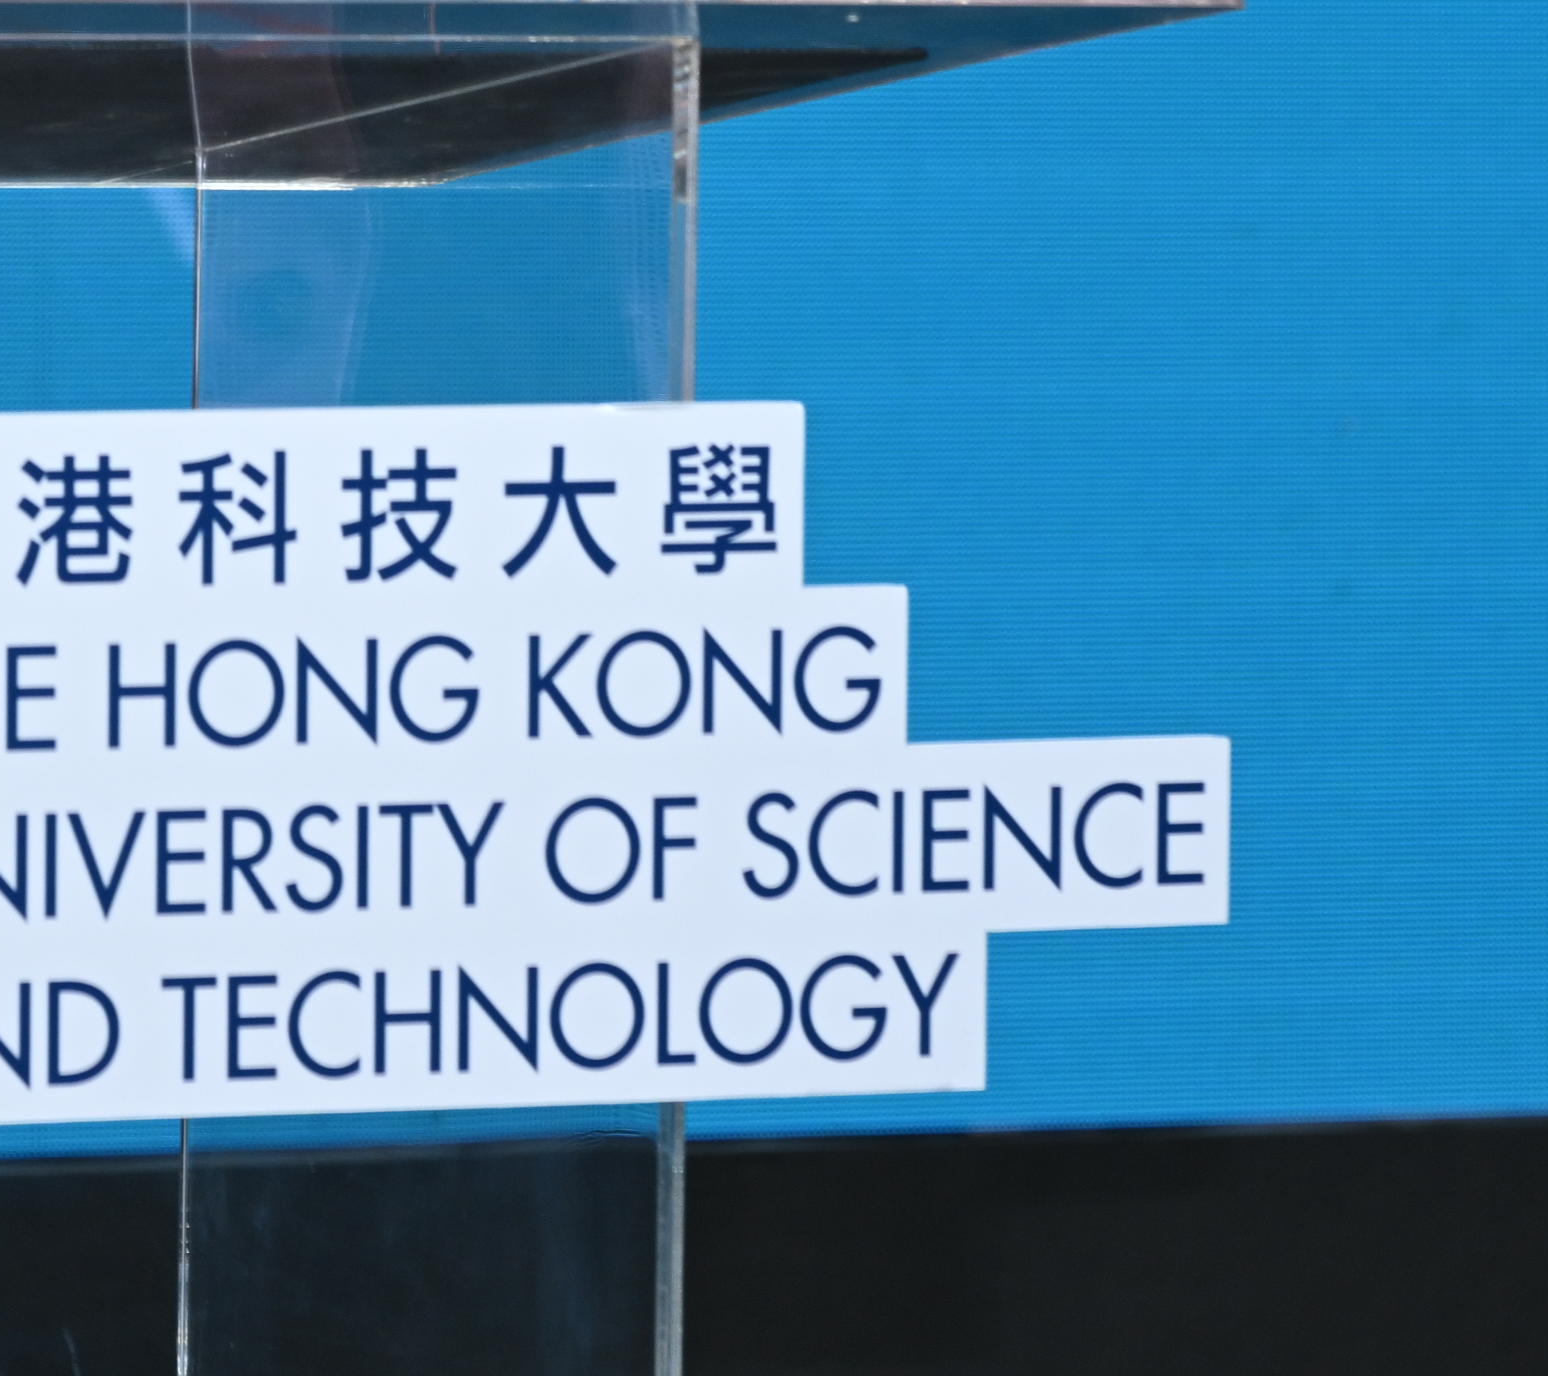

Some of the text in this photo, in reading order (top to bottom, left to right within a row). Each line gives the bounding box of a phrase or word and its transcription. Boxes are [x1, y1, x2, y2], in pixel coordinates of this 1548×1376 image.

[107, 634, 481, 750] HONG
[527, 625, 883, 740] KONG
[544, 796, 699, 906] OF
[741, 781, 1206, 900] SCIENCE
[160, 952, 960, 1082] TECHNOLOGY
